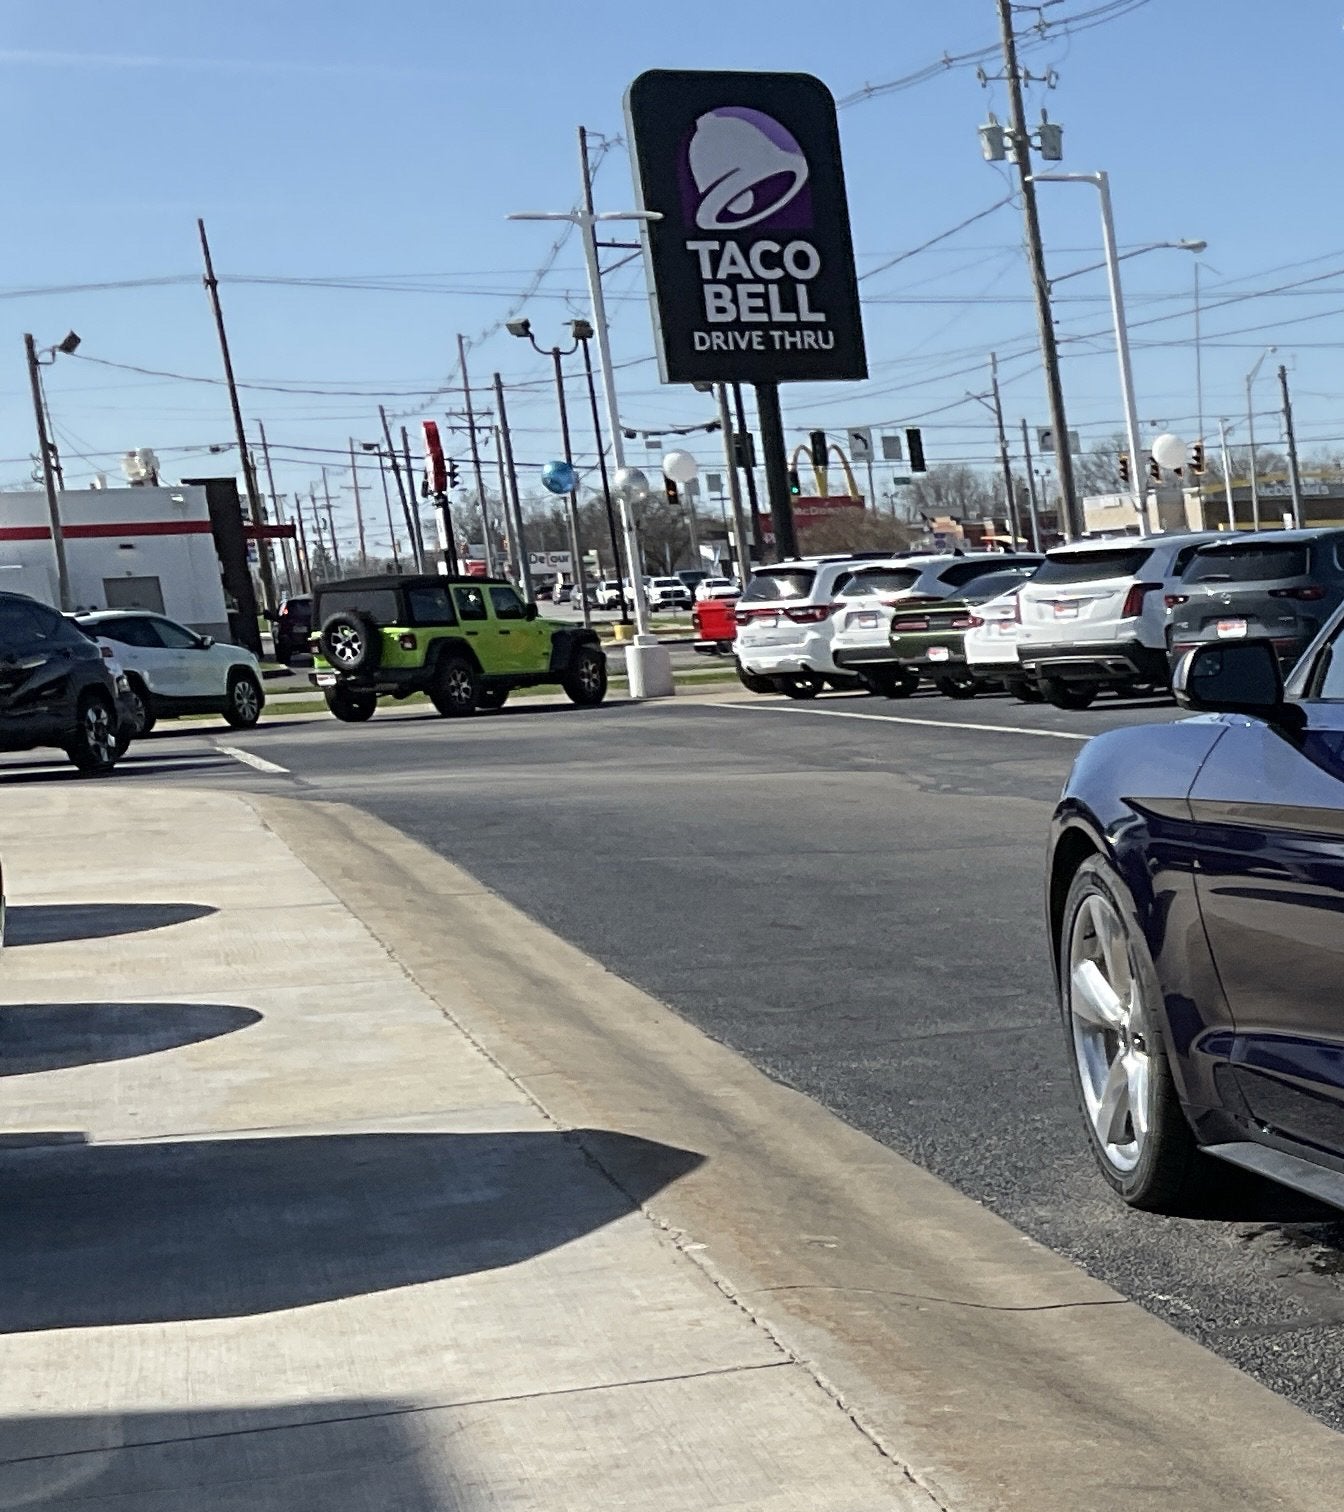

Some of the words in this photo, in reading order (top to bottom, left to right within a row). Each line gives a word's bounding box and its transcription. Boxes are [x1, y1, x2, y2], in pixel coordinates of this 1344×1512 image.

[686, 240, 821, 280] TACO
[703, 283, 826, 322] BELL
[693, 331, 766, 351] DRIVE
[769, 330, 835, 350] THRU
